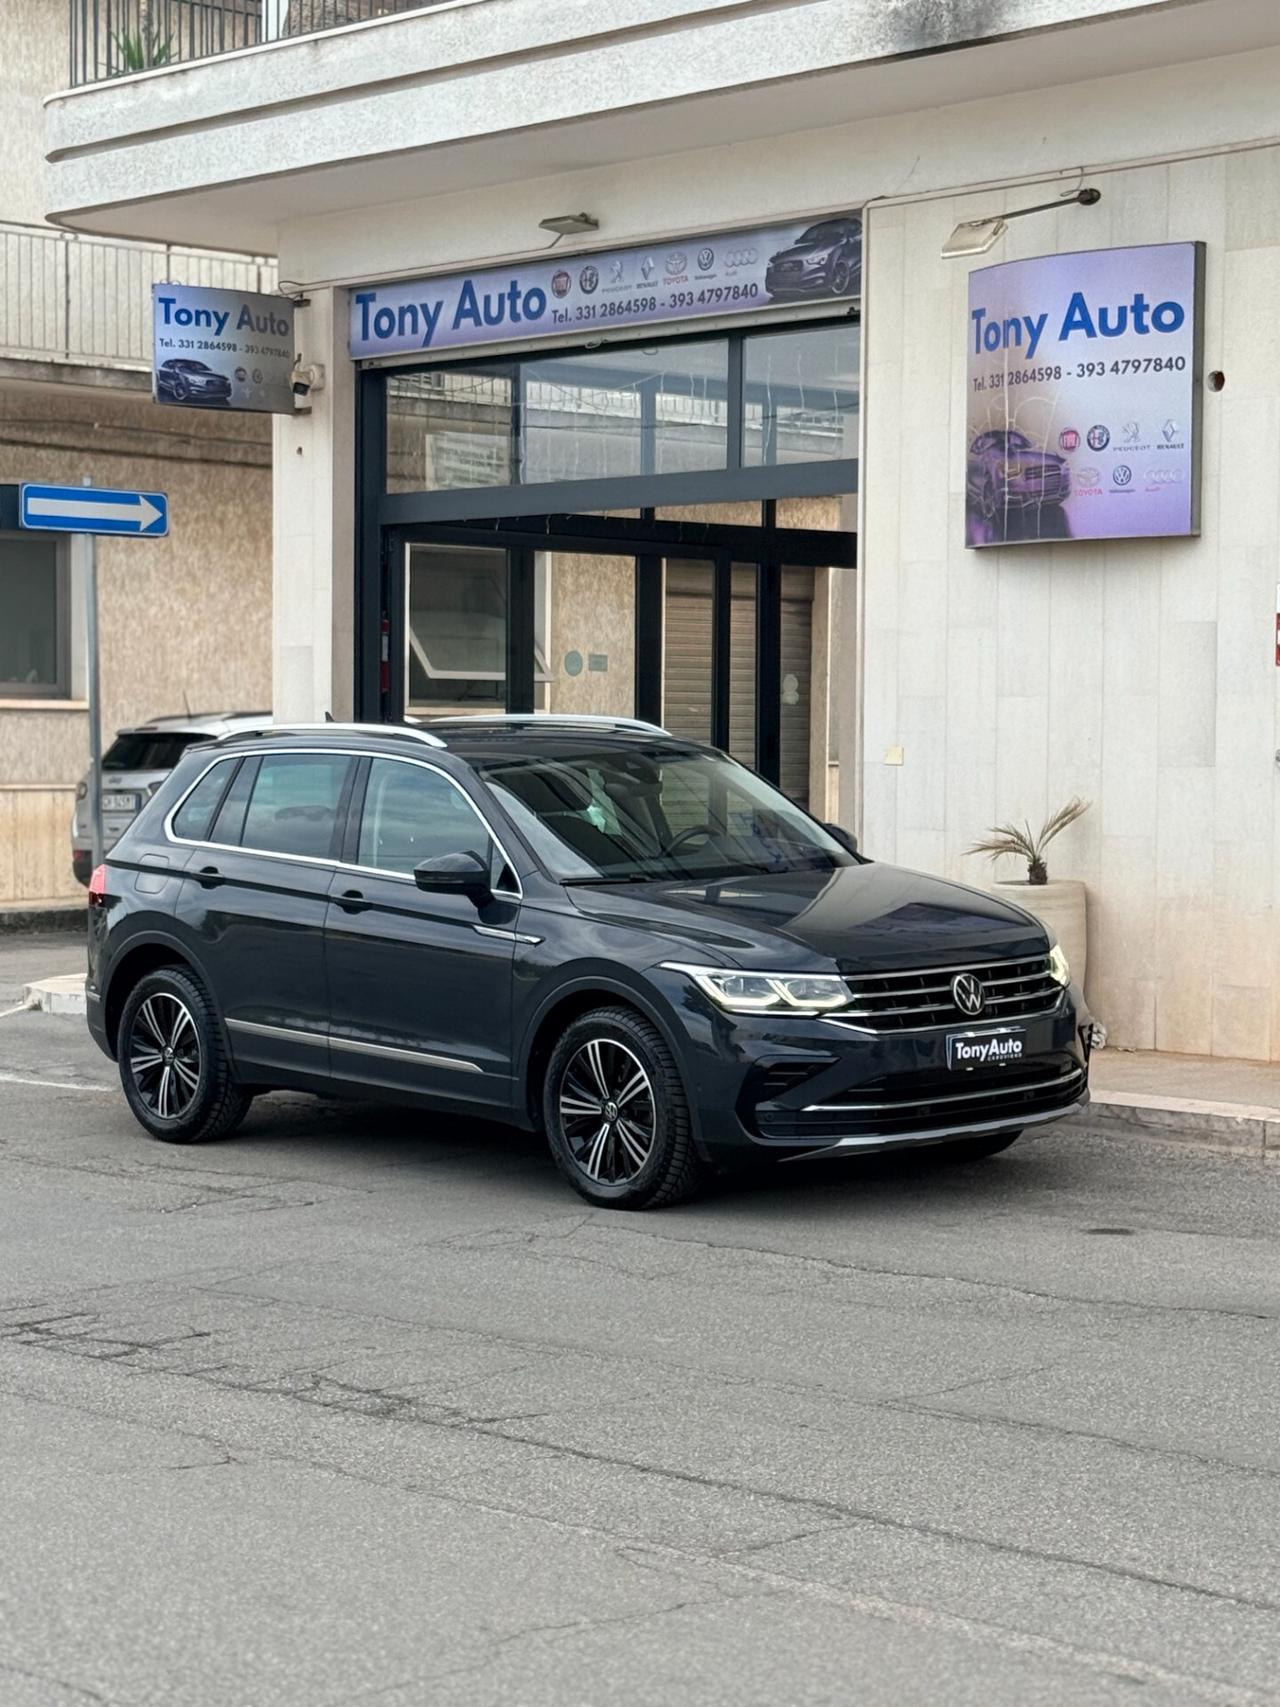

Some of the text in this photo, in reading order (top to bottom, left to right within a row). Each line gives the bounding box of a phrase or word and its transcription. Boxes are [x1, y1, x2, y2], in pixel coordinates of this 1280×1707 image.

[663, 275, 688, 286] TOYOTA
[158, 297, 290, 337] Tony Auto
[355, 280, 547, 347] Tony Auto
[552, 307, 572, 324] Tel.
[576, 305, 597, 320] 331
[600, 297, 657, 318] 2864598
[669, 292, 694, 308] 393
[697, 283, 759, 304] 4797840
[971, 292, 1185, 359] Tony Auto
[160, 338, 176, 348] Tel.
[178, 339, 194, 349] 331
[197, 341, 238, 353] 2864598
[974, 378, 987, 392] Tel.
[989, 374, 1004, 390] 331
[1008, 366, 1062, 386] 2864598
[1076, 362, 1106, 379] 393
[1110, 356, 1186, 375] 4797840
[1113, 444, 1151, 452] PEUGEOT
[1074, 488, 1103, 497] TOYOTA
[955, 1038, 1022, 1062] TonyAuto
